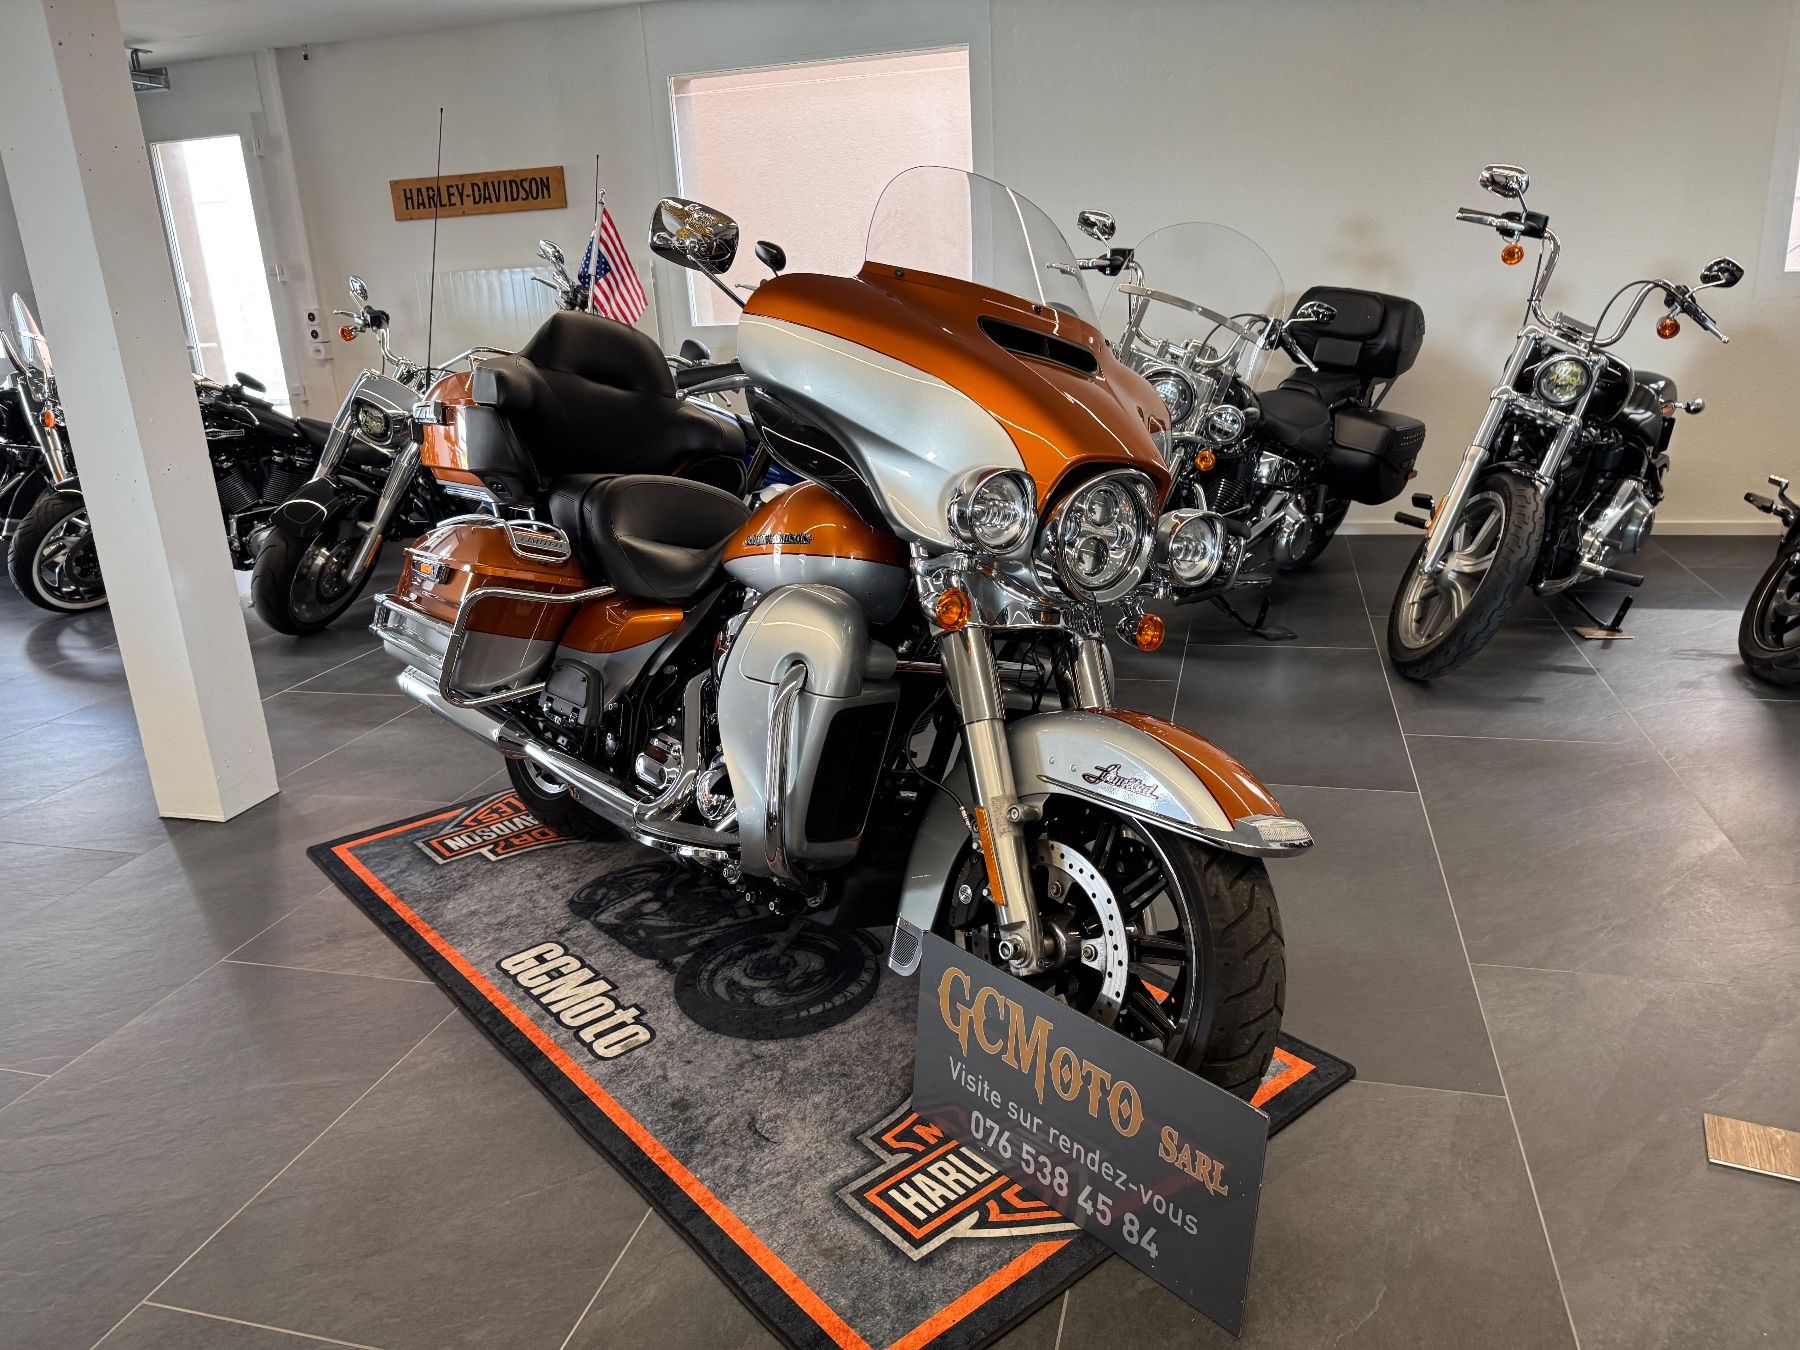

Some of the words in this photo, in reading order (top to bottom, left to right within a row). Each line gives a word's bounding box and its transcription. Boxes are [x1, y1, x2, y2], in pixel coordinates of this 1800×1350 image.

[403, 176, 552, 211] HARLEY-DAVIDSON
[499, 941, 652, 1059] GCMoto
[949, 1055, 1002, 1109] Visite
[1007, 1101, 1043, 1134] sur
[1048, 1126, 1199, 1236] rendez-vous
[970, 1110, 1012, 1159] 076
[1020, 1142, 1069, 1197] 538
[1077, 1184, 1113, 1226] 45
[1122, 1211, 1159, 1260] 84
[1158, 1125, 1229, 1197] SARL
